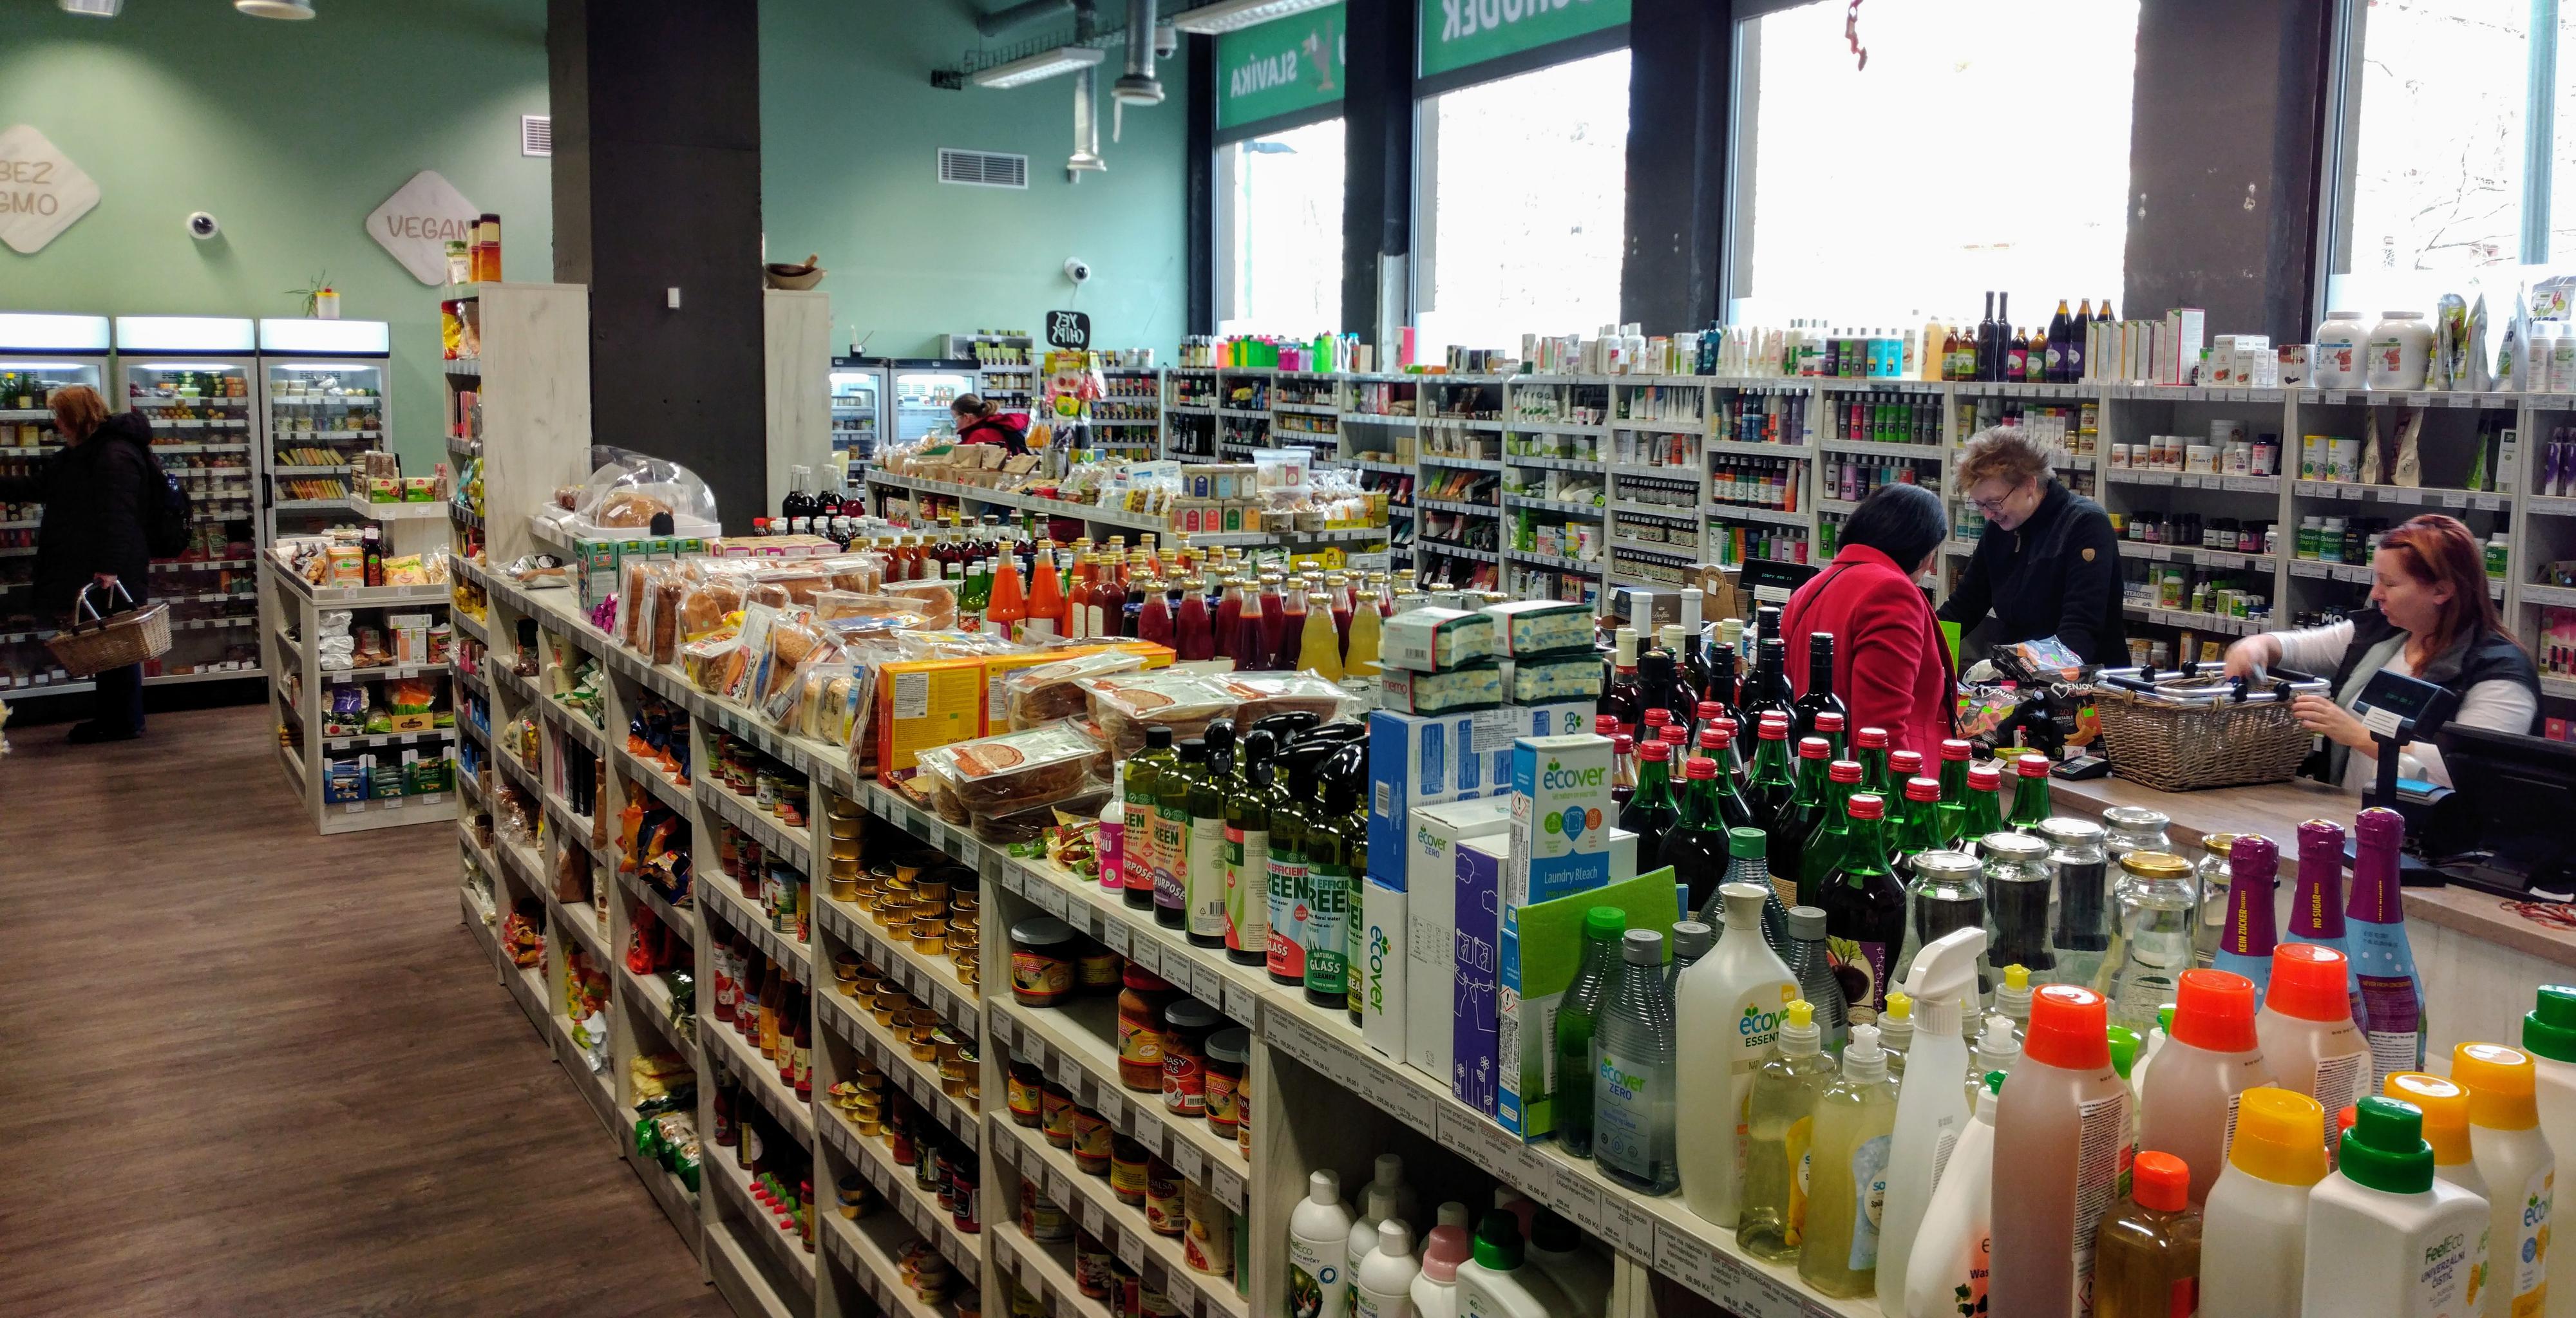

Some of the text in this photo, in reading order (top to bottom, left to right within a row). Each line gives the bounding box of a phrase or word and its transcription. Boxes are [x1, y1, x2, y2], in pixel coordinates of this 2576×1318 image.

[1652, 611, 1670, 620] Dolfin
[1382, 679, 1407, 694] memo
[1994, 688, 2020, 701] ENJOY
[1544, 767, 1605, 790] ecover
[1418, 829, 1446, 852] ecover
[1425, 845, 1440, 858] ZERO
[1272, 864, 1308, 876] EFFICIENT
[1545, 866, 1597, 884] Laundry Bleach
[2313, 894, 2321, 918] SUGAR
[2313, 918, 2322, 928] NO
[2238, 908, 2248, 953] KEIN ZUCKER
[1314, 952, 1335, 961] NATURAL
[1310, 960, 1341, 974] GLASS
[1370, 925, 1383, 1016] ecover
[1312, 972, 1336, 981] CLEANER
[1600, 1062, 1646, 1093] ecover
[1609, 1082, 1632, 1100] ZERO
[1457, 1141, 1471, 1154] 235,00
[1556, 1171, 1571, 1183] Ecover
[1150, 1180, 1173, 1190] SALSA
[1605, 1198, 1622, 1212] Ecover
[1578, 1213, 1599, 1230] 62,00 Kč
[1618, 1214, 1633, 1226] ZERO
[1658, 1226, 1676, 1242] Ecover
[1628, 1242, 1651, 1259] 60,90 Kč
[2425, 1233, 2464, 1265] FeelEco
[1685, 1274, 1701, 1288] 55,90
[1741, 1268, 1771, 1290] SODASAN
[2432, 1268, 2452, 1288] ČISTIČ
[1469, 1299, 1478, 1310] 40
